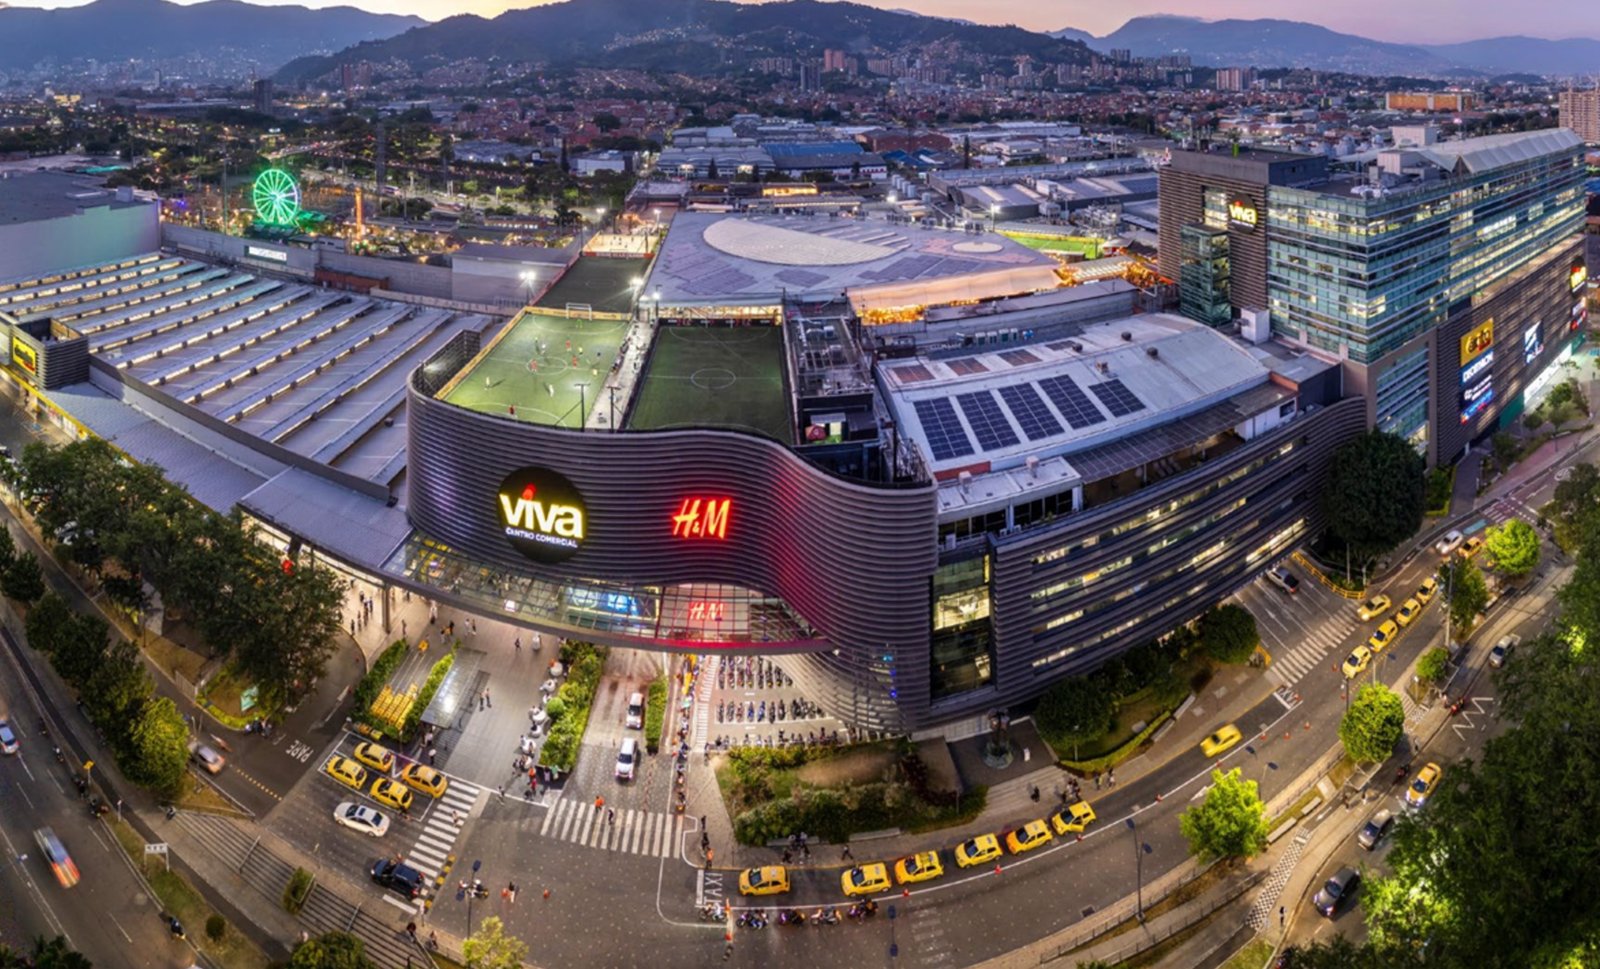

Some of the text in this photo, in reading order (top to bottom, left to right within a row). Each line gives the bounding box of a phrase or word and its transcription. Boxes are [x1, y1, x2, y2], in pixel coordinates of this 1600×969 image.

[1229, 201, 1258, 225] viva
[499, 483, 583, 539] viva
[672, 498, 730, 539] H&M
[505, 526, 578, 549] CENTRO COMERCIAL
[285, 739, 314, 763] PARE
[703, 872, 723, 905] TAXI
